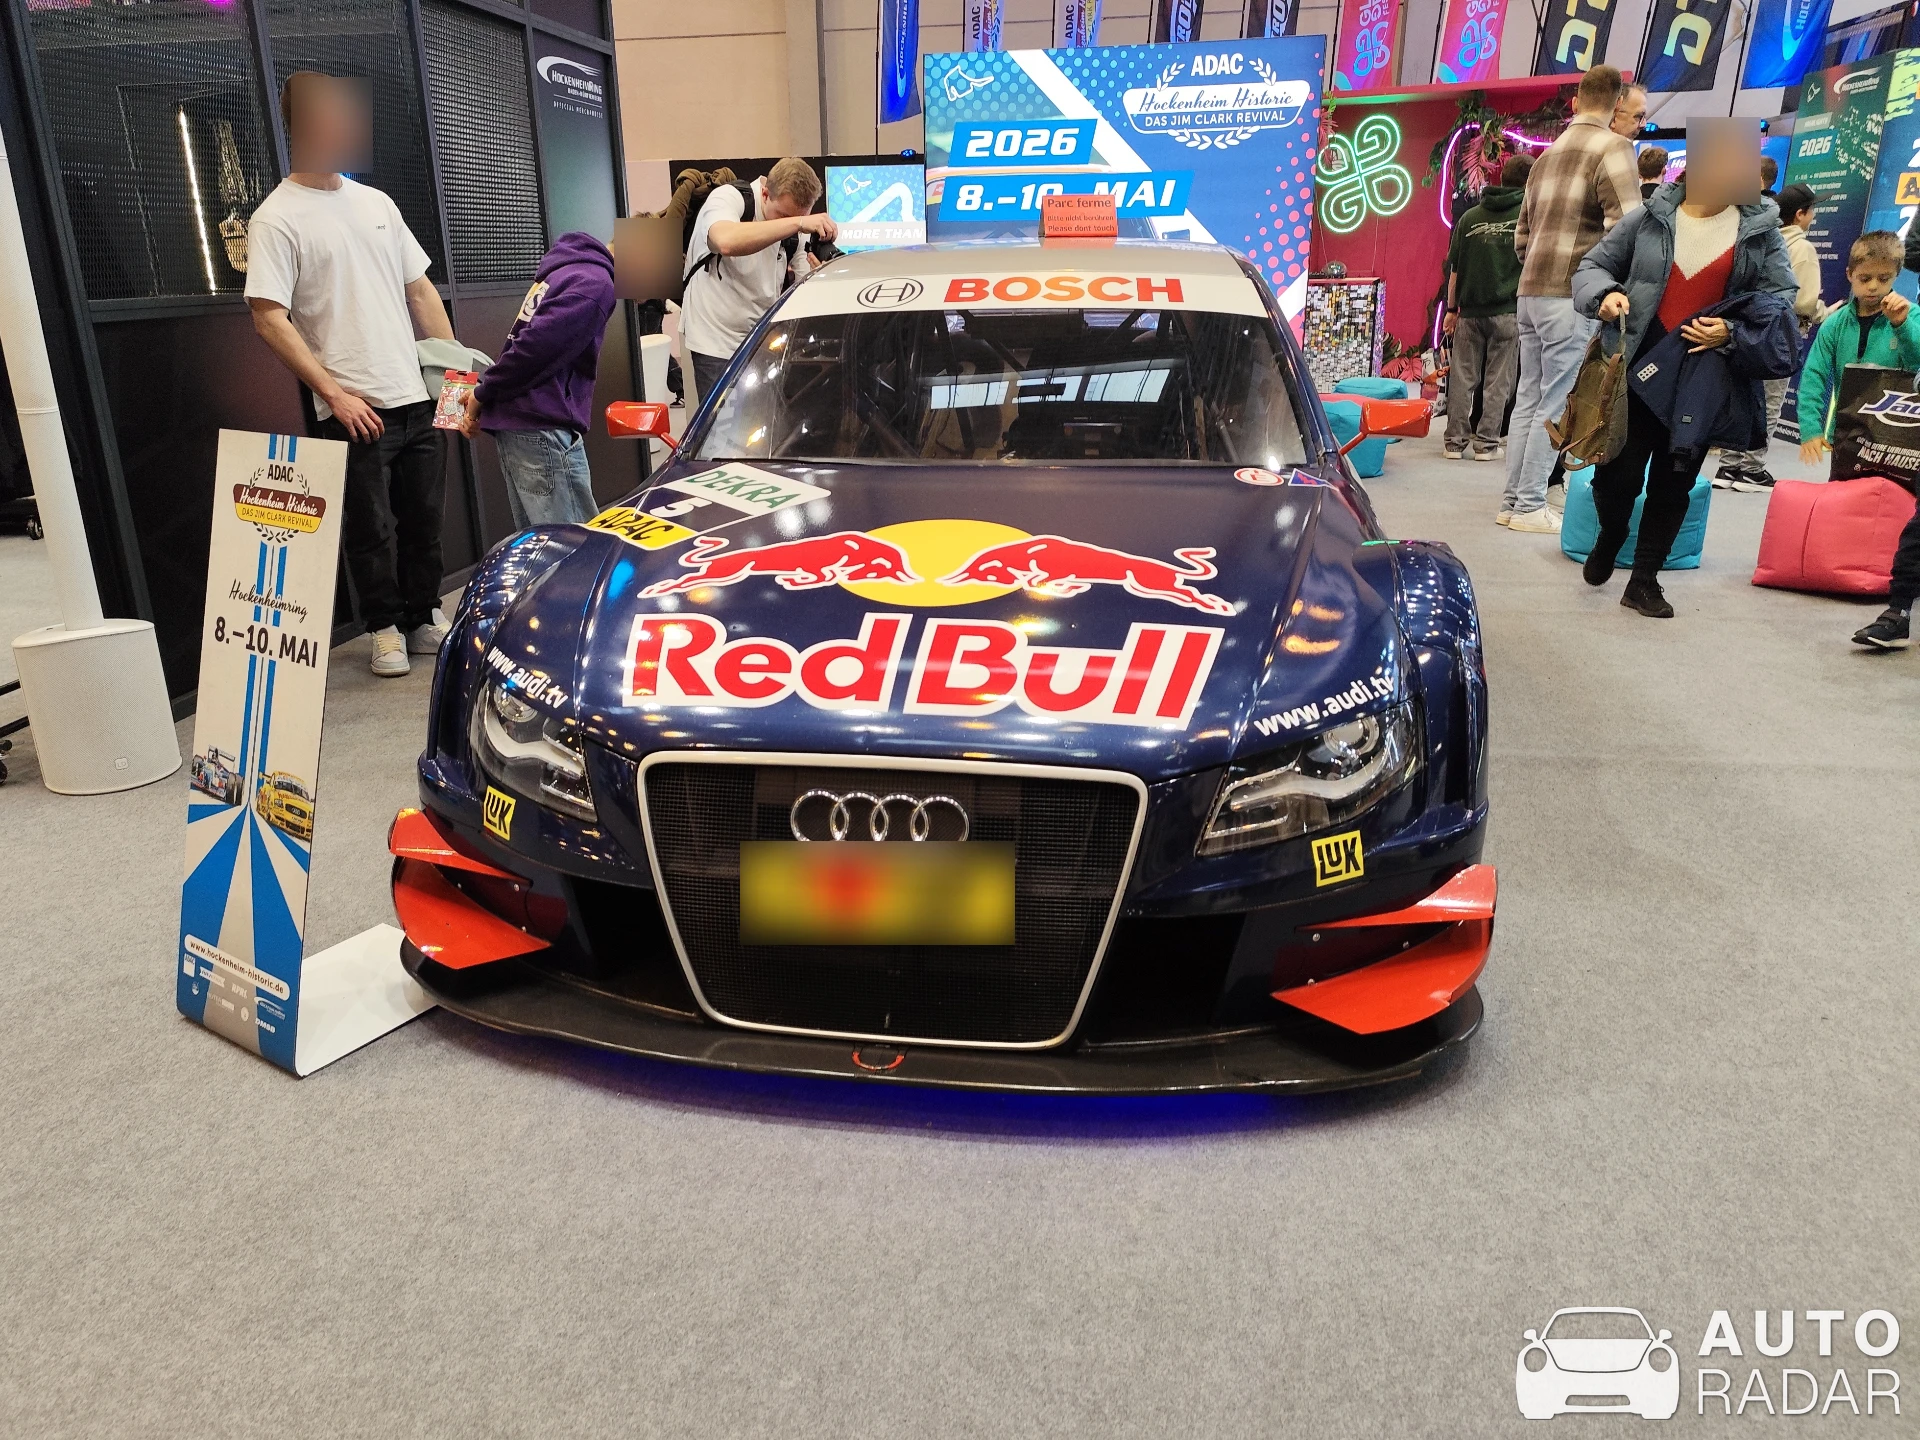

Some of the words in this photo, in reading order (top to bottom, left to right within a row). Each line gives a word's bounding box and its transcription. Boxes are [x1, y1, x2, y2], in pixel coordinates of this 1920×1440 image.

[972, 6, 980, 40] ADAC
[1065, 4, 1074, 39] ADAC
[1191, 53, 1244, 76] ADAC
[1139, 90, 1228, 112] Hockenheim
[1232, 87, 1293, 108] Historic
[1145, 116, 1168, 127] DAS
[1170, 114, 1191, 126] JIM
[1194, 113, 1233, 125] CLARK
[1236, 110, 1286, 123] REVIVAL
[965, 127, 1081, 158] 2026
[1799, 136, 1833, 158] 2026
[1047, 199, 1073, 208] Parc
[1077, 198, 1112, 208] ferme
[1093, 180, 1177, 209] MAI
[841, 228, 880, 239] MORE
[885, 228, 923, 239] THAN
[944, 277, 1184, 303] BOSCH
[1857, 446, 1884, 463] NACH
[267, 464, 294, 483] ADAC
[240, 486, 285, 509] Hockenheim
[285, 494, 318, 515] Historic
[685, 470, 801, 509] DEKRA
[242, 508, 253, 516] DAS
[255, 510, 265, 519] JIM
[267, 512, 286, 523] CLARK
[288, 515, 313, 528] REVIVAL
[591, 508, 675, 541] ADAC
[229, 578, 308, 624] Hockenheimring
[278, 632, 319, 668] MAI
[487, 646, 569, 709] www.audi.tv
[628, 615, 901, 707] Red
[911, 620, 1214, 724] Bull
[1254, 673, 1395, 737] www.audi.tv
[190, 941, 284, 994] www.hockenheim-historic.de
